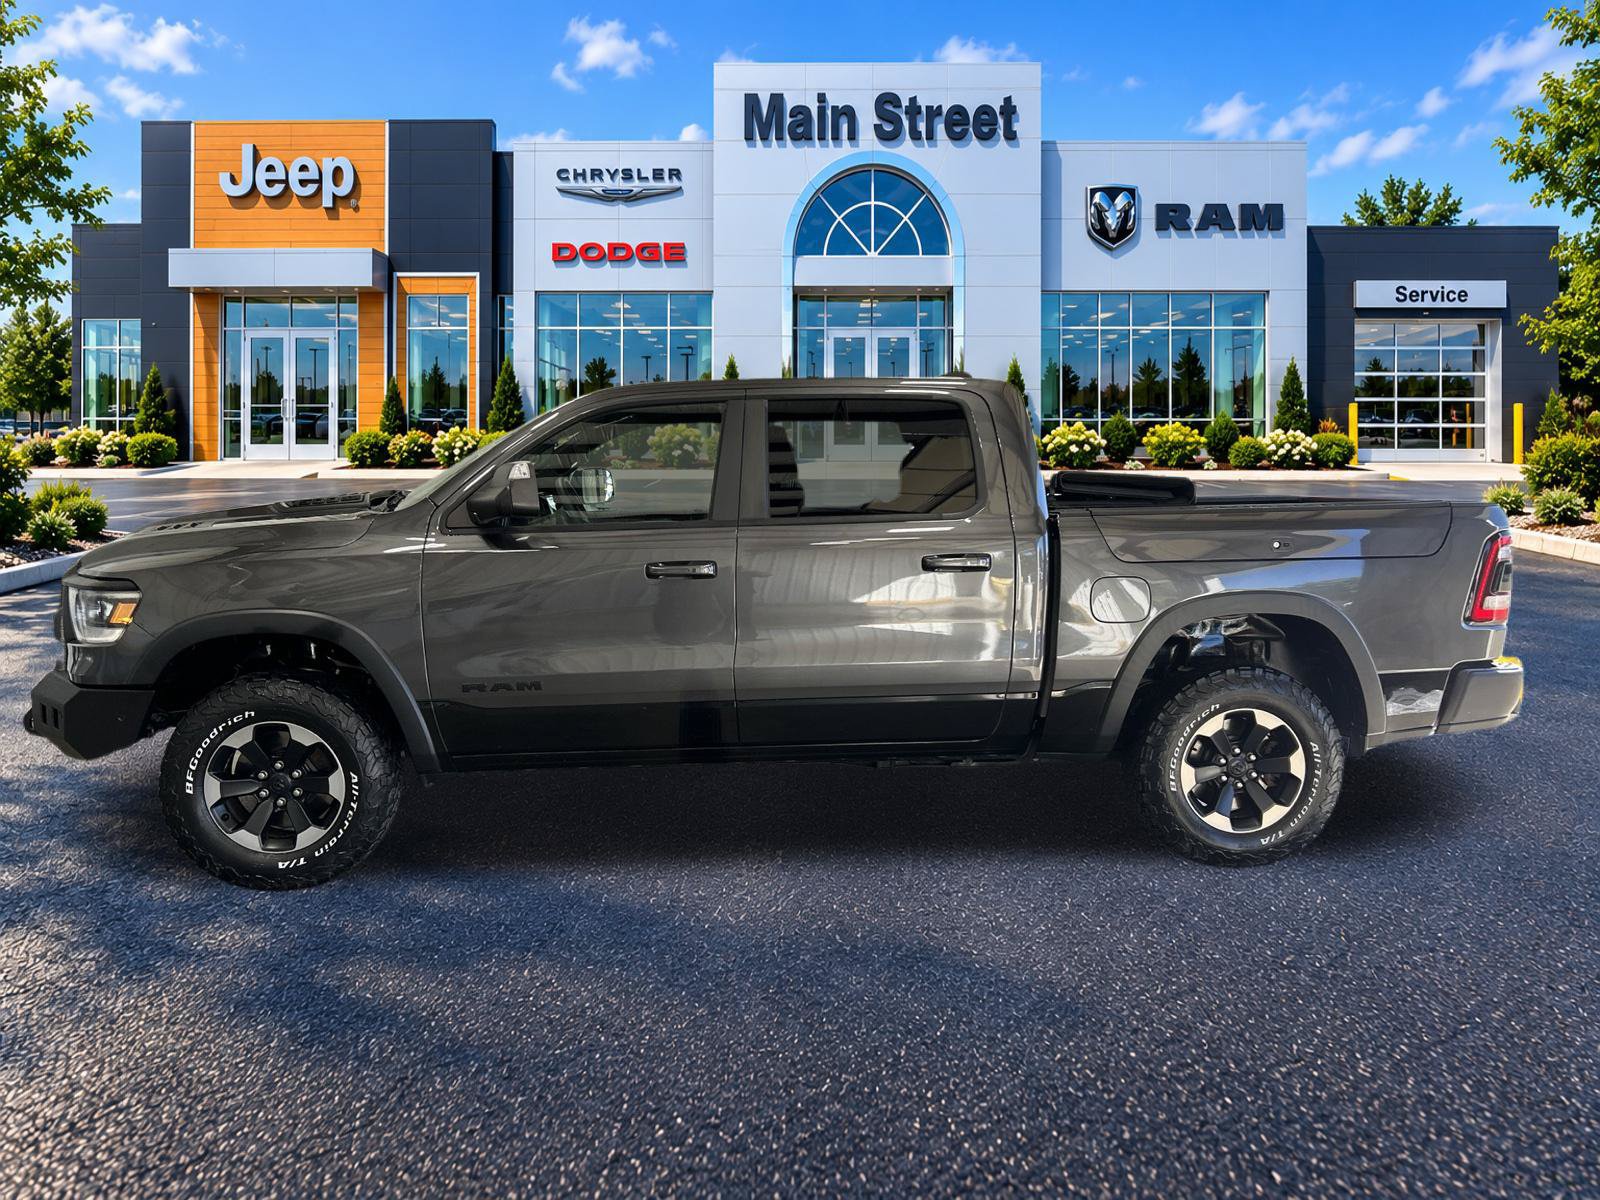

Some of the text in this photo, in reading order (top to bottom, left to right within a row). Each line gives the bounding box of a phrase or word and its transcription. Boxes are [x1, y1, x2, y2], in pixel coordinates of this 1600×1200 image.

[744, 91, 1018, 141] Main Street
[219, 143, 355, 208] Jeep
[556, 167, 682, 182] CHRYSLER
[1154, 203, 1284, 232] RAM
[551, 242, 687, 262] DODGE
[1395, 285, 1469, 303] Service
[461, 680, 543, 693] RAM
[185, 711, 255, 795] BFGoodrich
[1169, 703, 1220, 792] BFGoodrich
[277, 771, 359, 869] All-Terrain T/A
[1260, 829, 1286, 846] T/A
